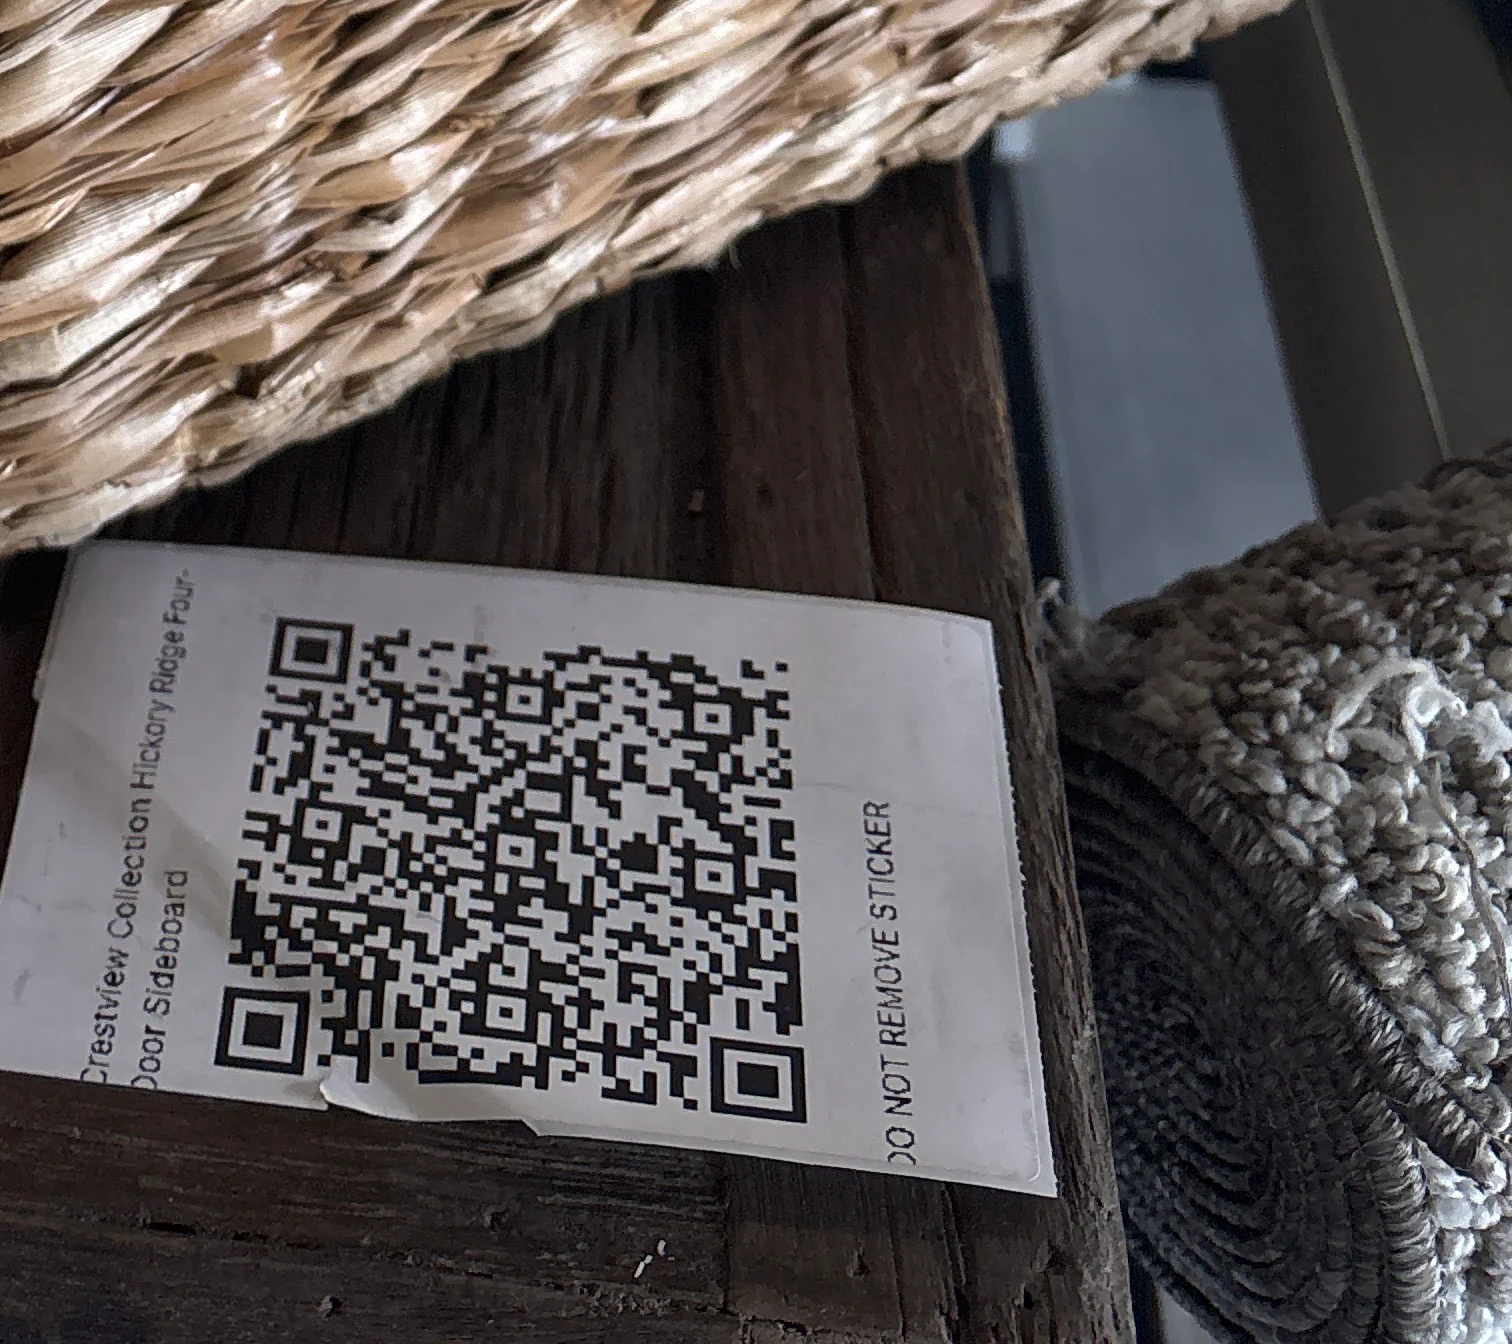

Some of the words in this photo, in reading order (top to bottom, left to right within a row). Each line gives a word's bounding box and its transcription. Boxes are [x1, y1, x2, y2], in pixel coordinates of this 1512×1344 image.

[148, 629, 187, 694] Ridge
[129, 699, 176, 790] Hickory
[107, 797, 152, 939] Collection
[862, 799, 898, 921] STICKER
[143, 869, 189, 1016] Sideboard
[871, 927, 909, 1047] REMOVE
[80, 946, 130, 1083] Crestview
[879, 1053, 913, 1116] NOT
